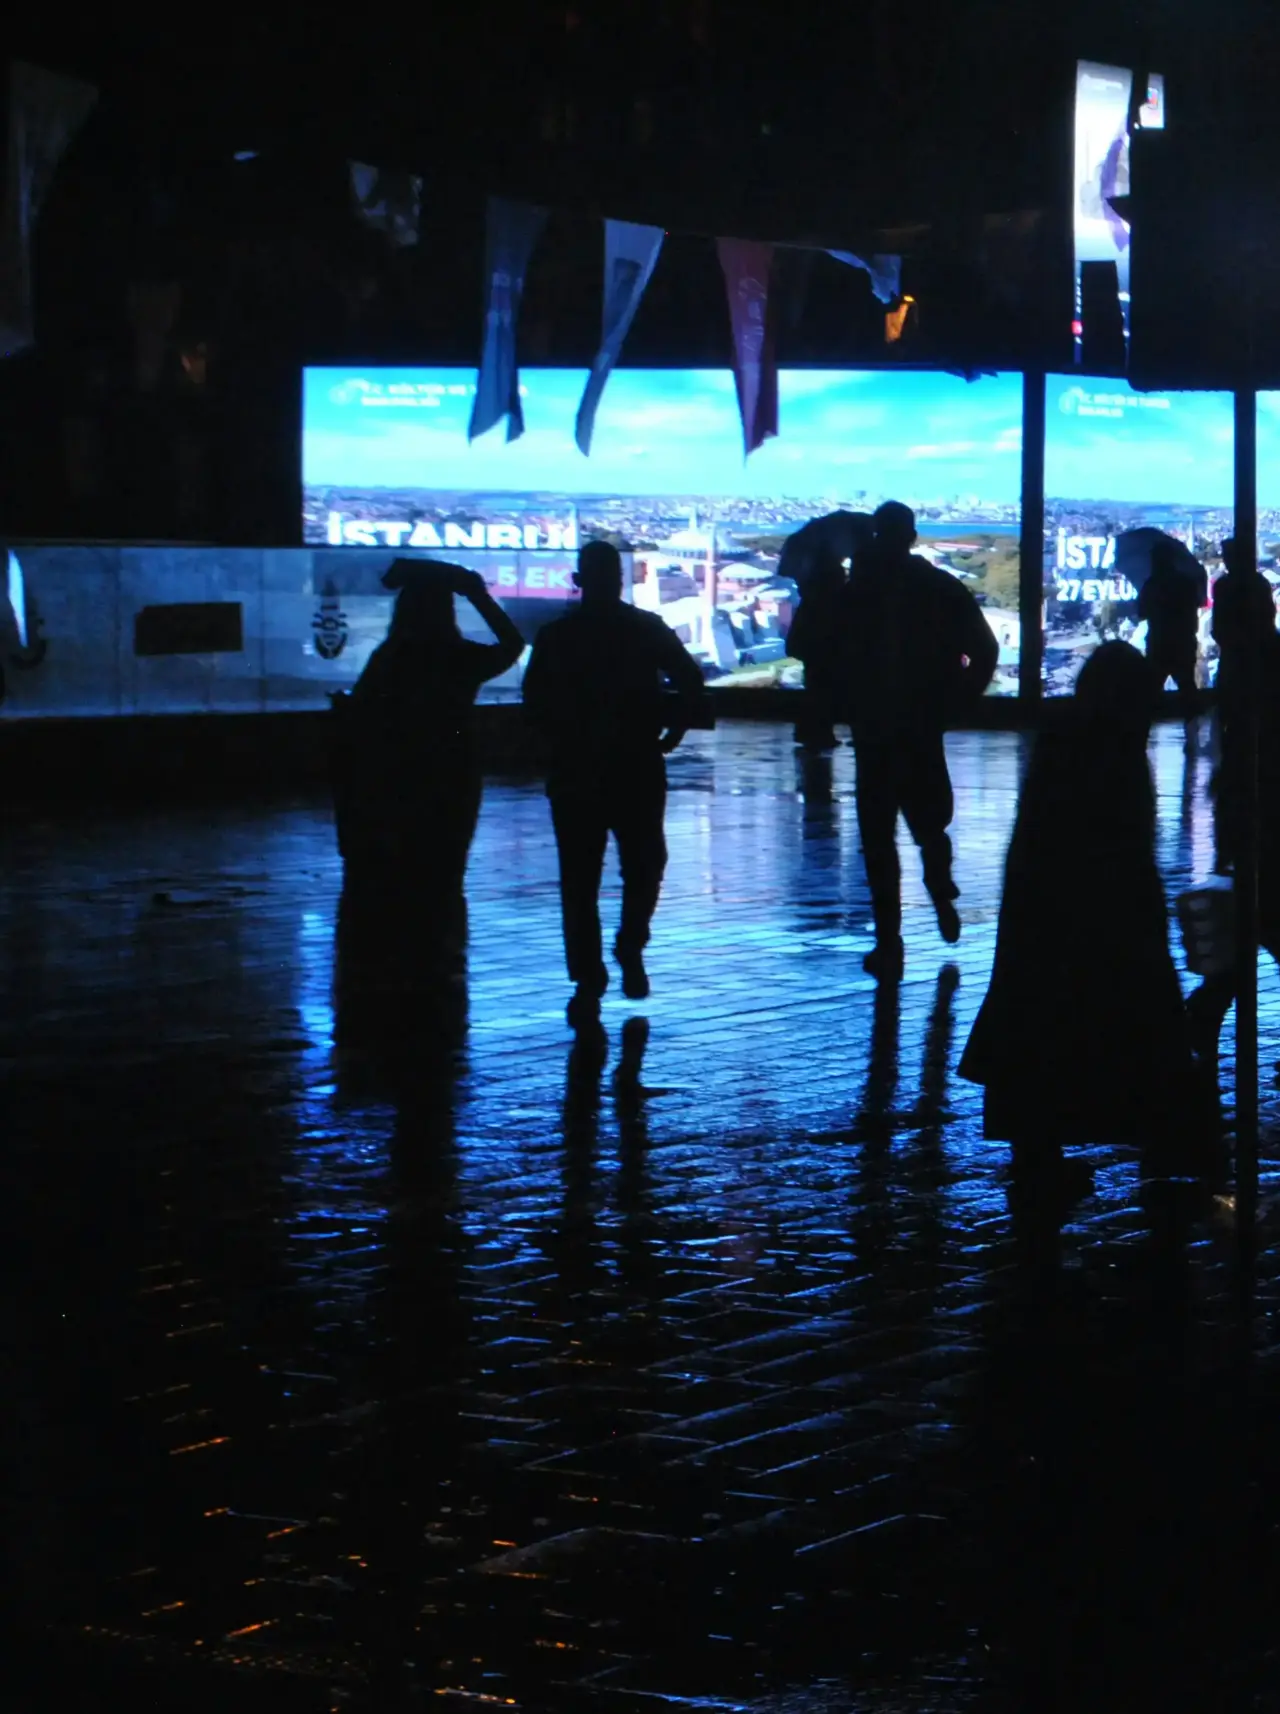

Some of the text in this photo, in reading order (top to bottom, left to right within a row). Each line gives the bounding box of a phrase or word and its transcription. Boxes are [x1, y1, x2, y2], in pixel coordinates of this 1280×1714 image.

[1057, 527, 1117, 569] İSTA
[497, 565, 518, 588] 5
[1056, 578, 1082, 602] 27
